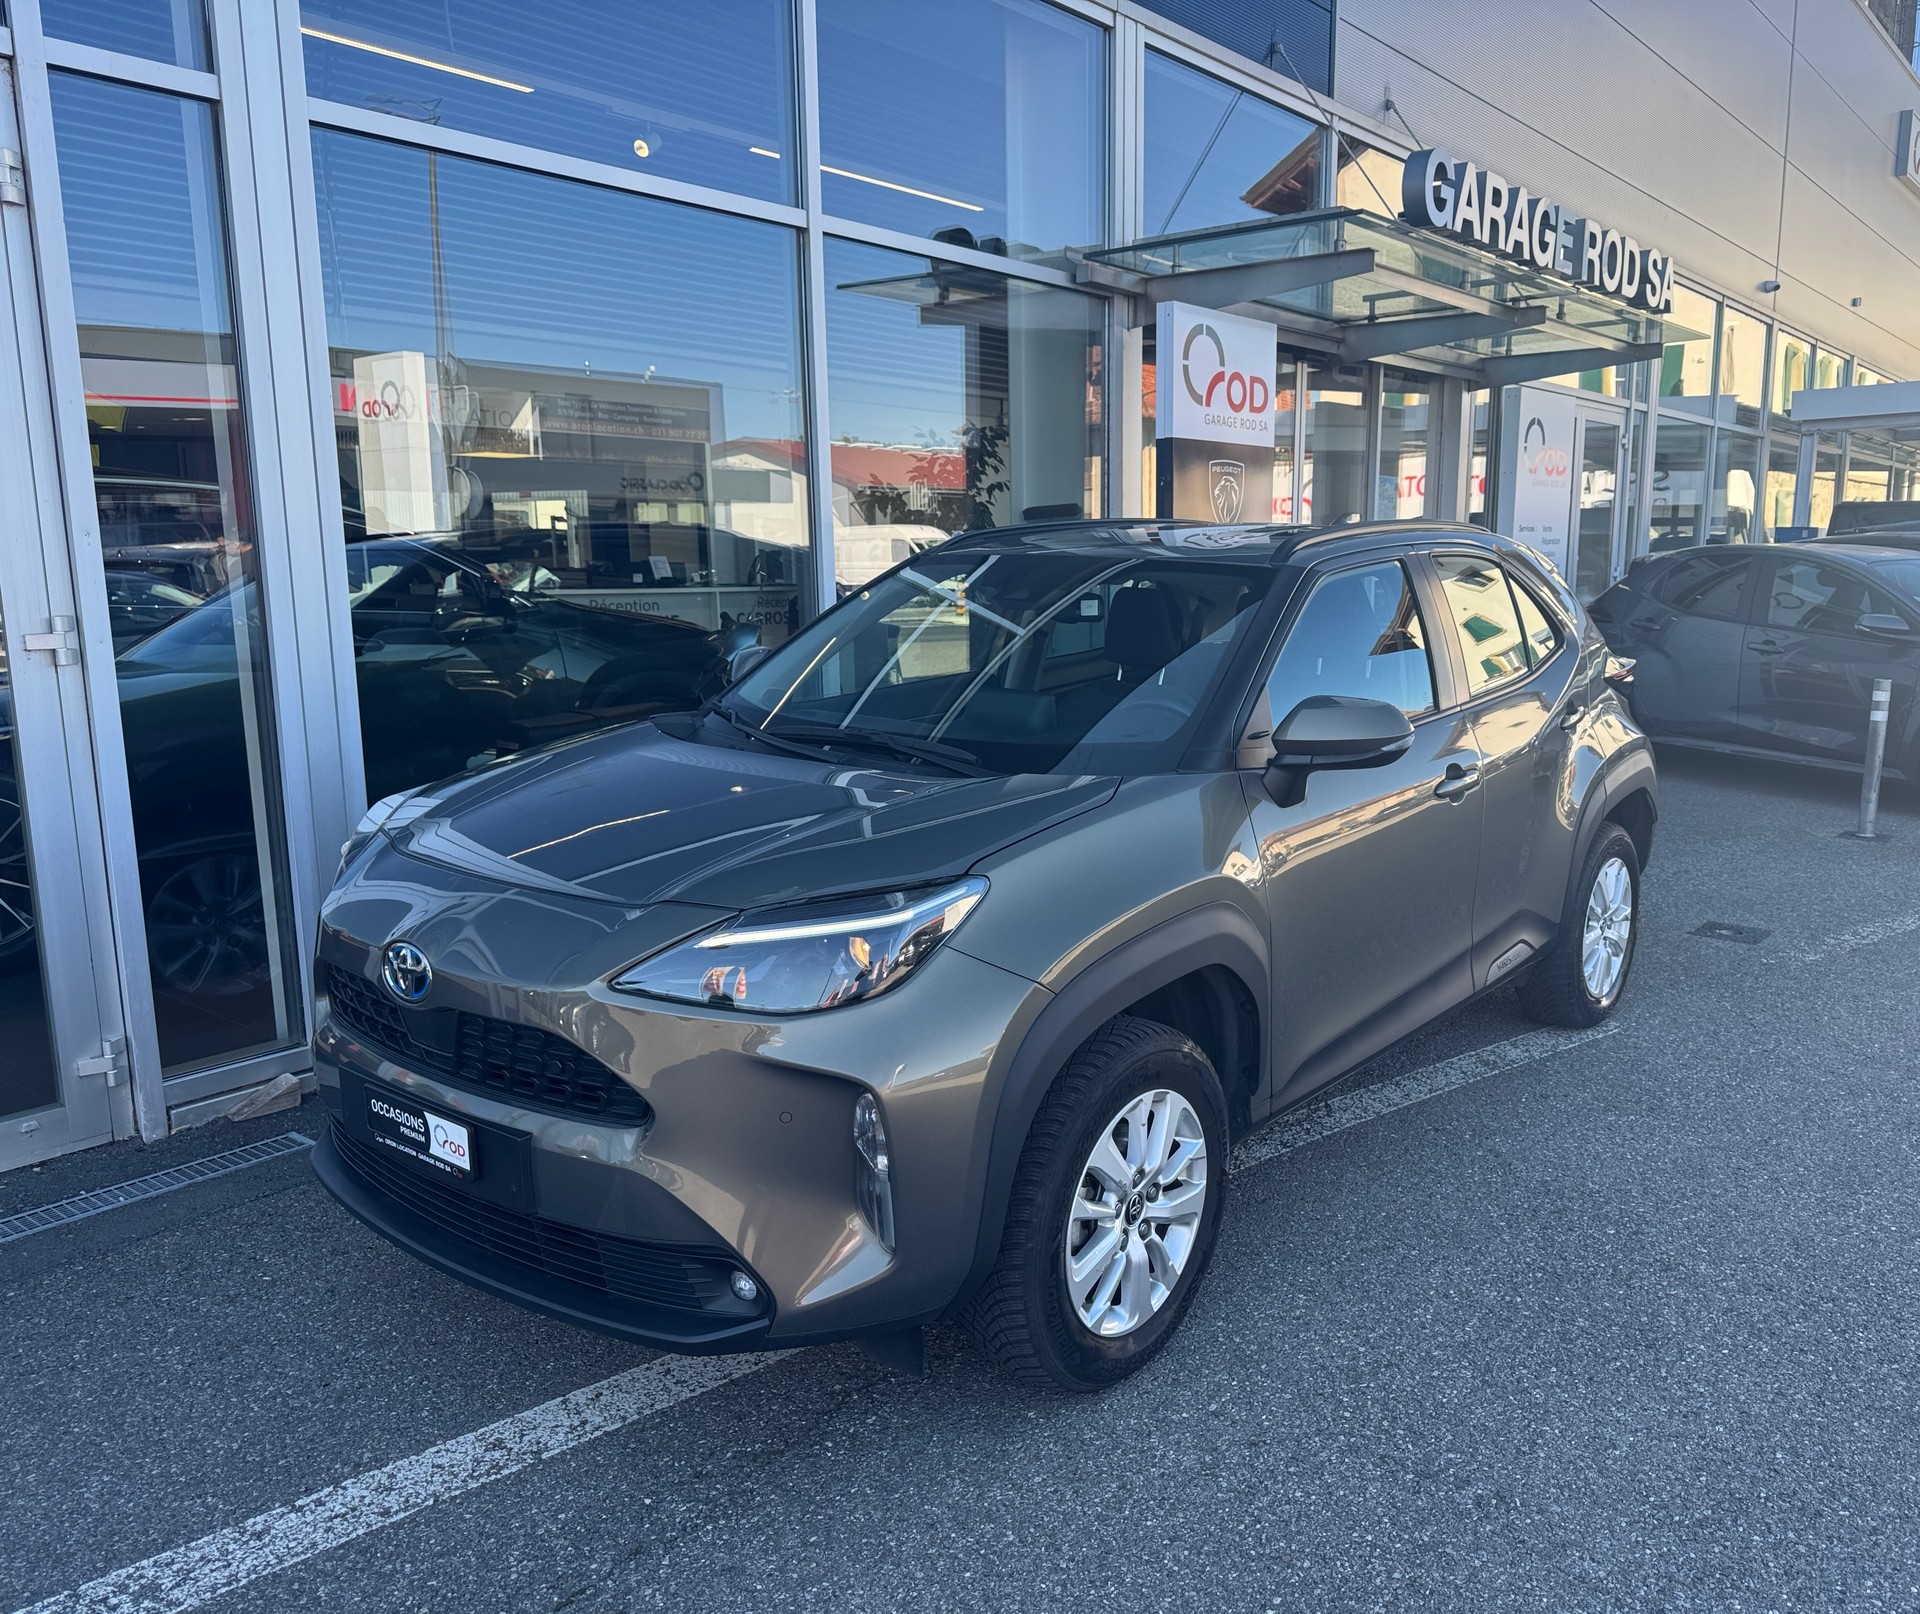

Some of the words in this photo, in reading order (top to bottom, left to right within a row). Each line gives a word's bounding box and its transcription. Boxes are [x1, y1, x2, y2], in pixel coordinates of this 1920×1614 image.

[1423, 147, 1577, 276] GARAGE
[1580, 218, 1641, 298] ROD
[1646, 248, 1674, 313] SA
[1204, 413, 1238, 428] GARAGE
[1240, 418, 1257, 430] ROD
[1259, 420, 1268, 431] SA
[1211, 465, 1242, 474] PEUGEOT
[371, 1098, 425, 1132] OCCASIONS
[400, 1126, 426, 1144] PREMIUM
